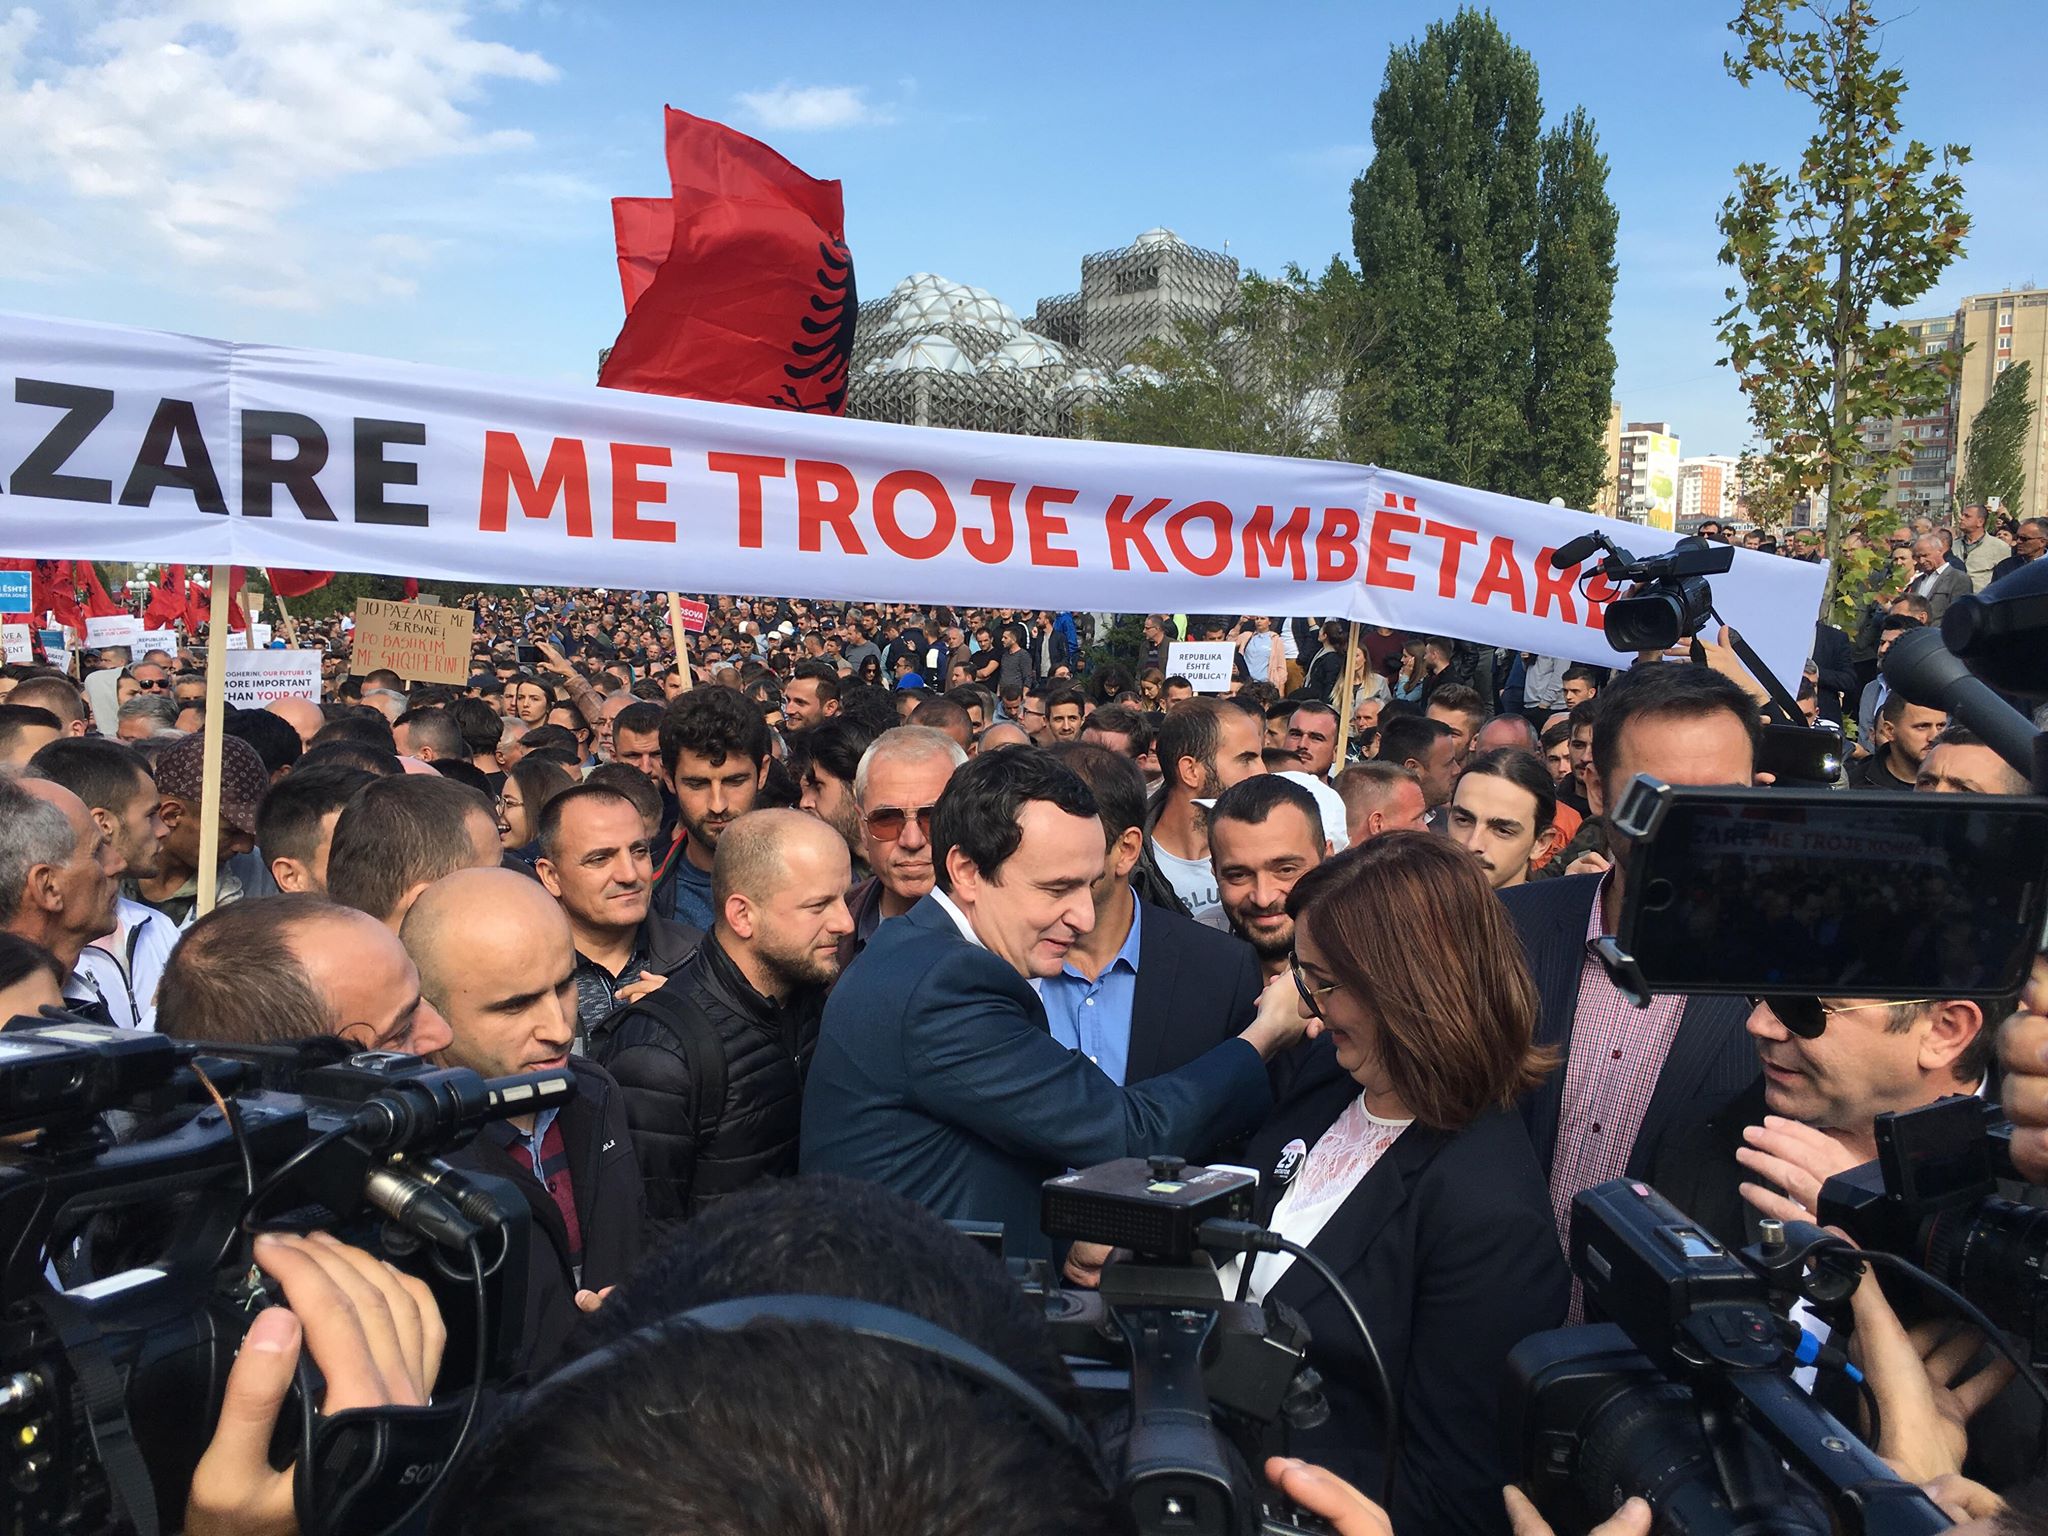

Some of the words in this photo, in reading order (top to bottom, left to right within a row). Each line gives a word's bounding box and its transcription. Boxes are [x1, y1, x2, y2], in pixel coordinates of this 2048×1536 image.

[0, 377, 429, 528] ZARE
[479, 430, 677, 543] ME
[708, 451, 1080, 568] TROJE
[362, 601, 379, 615] JO
[383, 602, 441, 624] PAZARE
[450, 614, 466, 627] ME
[388, 620, 446, 640] SERBINE!
[361, 631, 378, 645] PO
[383, 635, 446, 655] BASHKIM
[356, 648, 372, 667] ME
[1179, 653, 1222, 661] REPUBLIKA
[1186, 662, 1210, 670] ËSHTË
[252, 679, 312, 687] IMPORTANT
[257, 691, 290, 700] YOUR
[1276, 1151, 1297, 1169] 29
